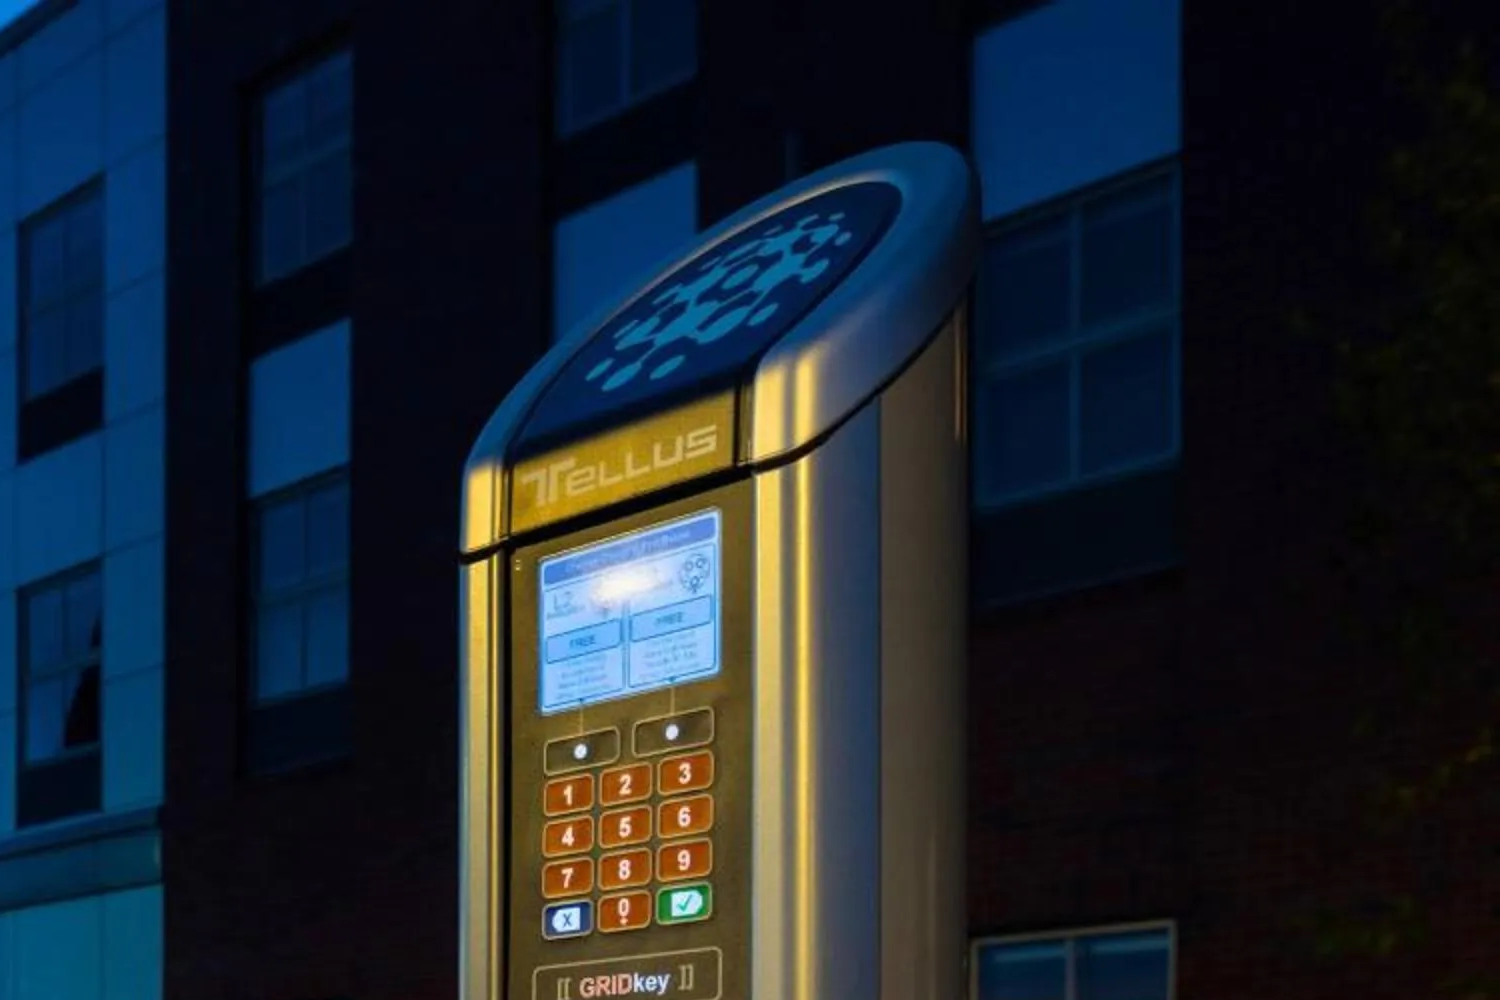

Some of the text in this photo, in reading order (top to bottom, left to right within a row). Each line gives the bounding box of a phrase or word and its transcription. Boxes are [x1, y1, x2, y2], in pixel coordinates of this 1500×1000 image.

[563, 763, 692, 805] 1 2 3
[561, 806, 691, 847] 4 5 6
[561, 850, 691, 889] 7 8 9
[618, 898, 629, 917] 0
[579, 971, 670, 998] GRIDkey
